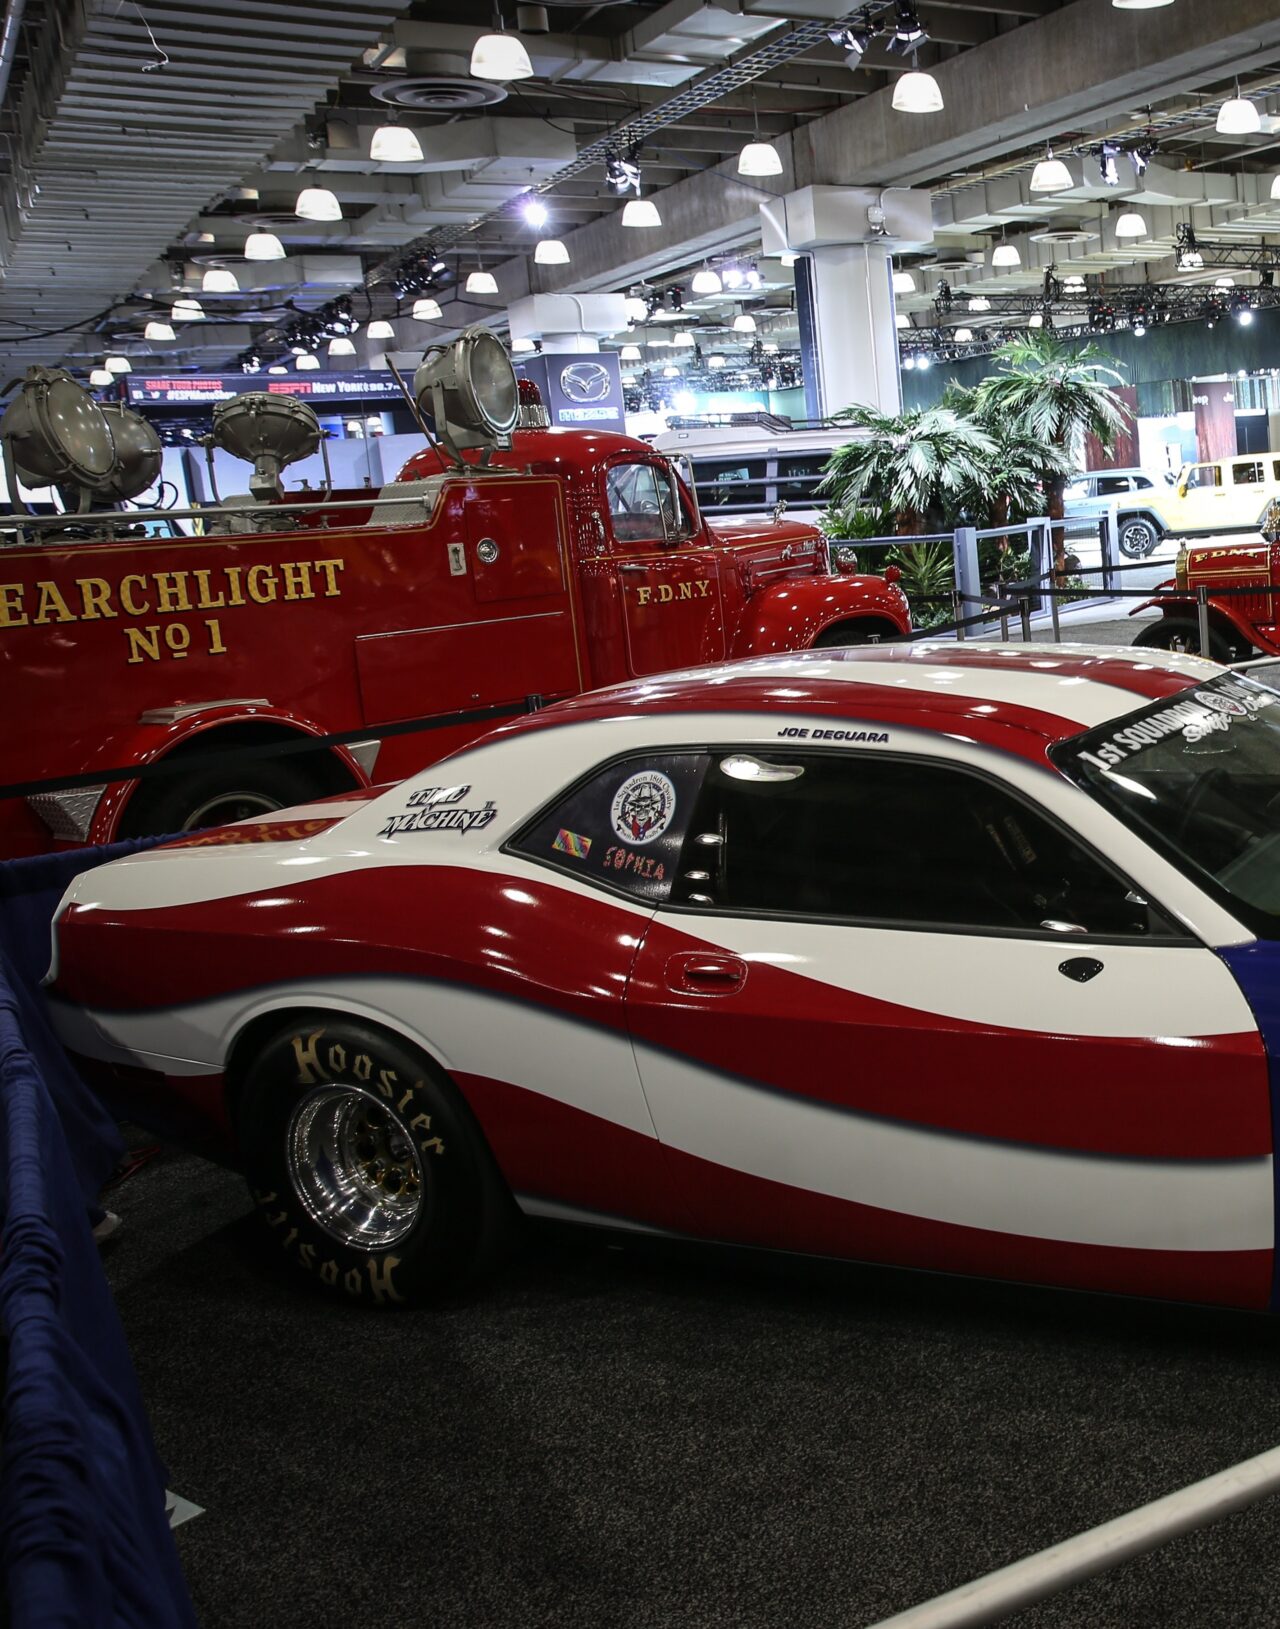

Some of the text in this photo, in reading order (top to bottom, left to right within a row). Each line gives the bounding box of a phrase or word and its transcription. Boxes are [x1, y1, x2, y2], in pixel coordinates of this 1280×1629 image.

[268, 382, 312, 395] ESPN
[0, 559, 344, 627] EARCHLIGHT
[637, 580, 712, 605] F.D.N.Y.
[204, 619, 228, 655] 1
[777, 727, 890, 744] JOE DEGUARA
[1077, 740, 1128, 771] 1st
[1113, 700, 1213, 752] SQUADRON
[377, 808, 497, 838] MACHINE
[291, 1027, 446, 1154] Hoosier
